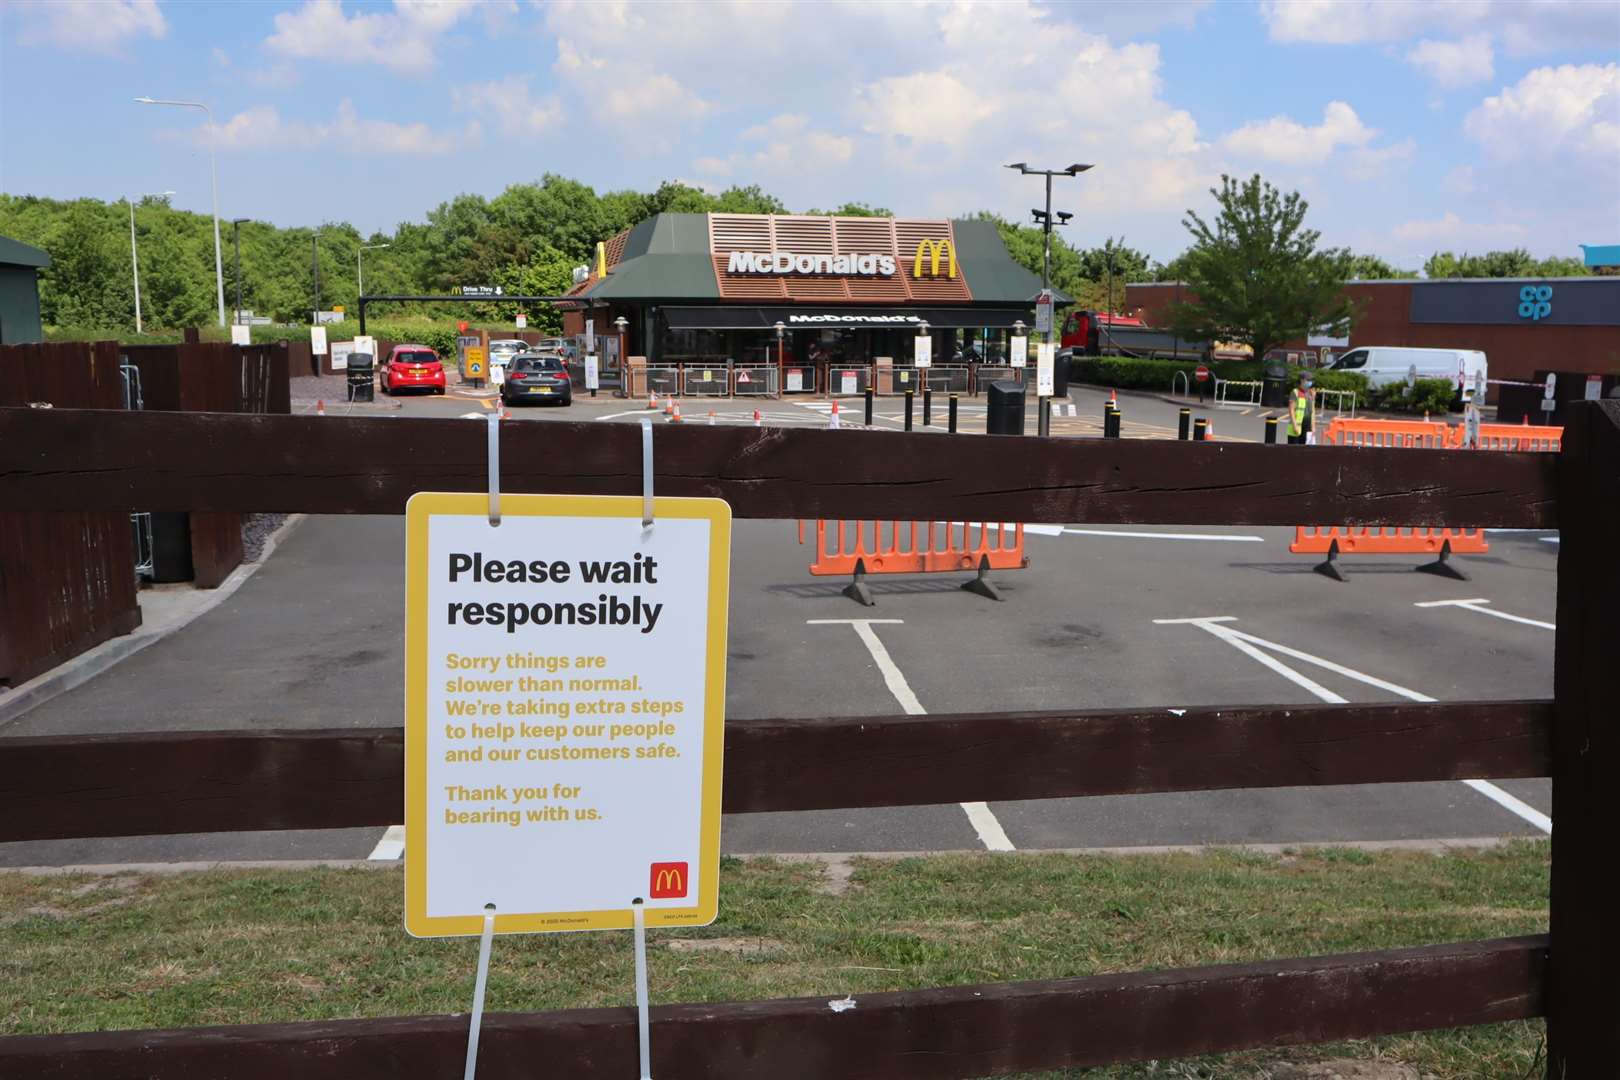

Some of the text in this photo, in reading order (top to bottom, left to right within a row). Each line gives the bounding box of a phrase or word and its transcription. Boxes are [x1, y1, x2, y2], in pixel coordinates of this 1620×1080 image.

[728, 252, 896, 275] McDonald's
[790, 314, 921, 323] McDonald's
[448, 552, 658, 585] Please wait
[447, 594, 664, 634] responsibly
[446, 653, 606, 675] Sorry things are
[446, 675, 643, 694] slower than normal.
[446, 699, 684, 719] We're taking extra steps
[445, 720, 676, 741] to help keep our people
[445, 742, 682, 763] and our customers safe.
[445, 783, 582, 805] Thank you for
[445, 805, 604, 828] bearing with us.
